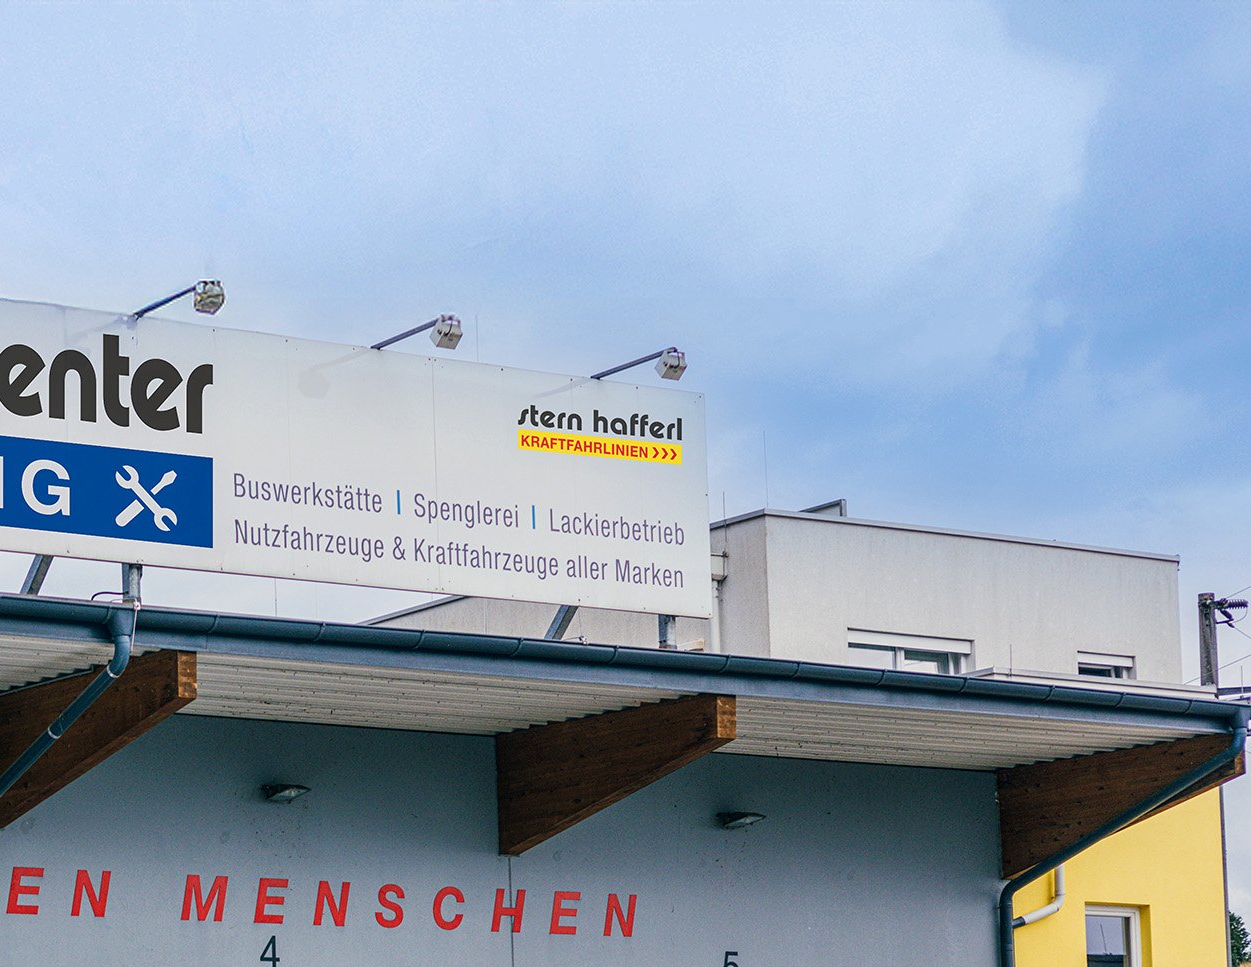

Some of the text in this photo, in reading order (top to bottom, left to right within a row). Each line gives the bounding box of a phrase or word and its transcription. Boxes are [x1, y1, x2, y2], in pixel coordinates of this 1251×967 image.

[518, 405, 683, 441] stern hafferl
[521, 435, 649, 459] KRAFTFAHRLINIEN
[233, 473, 685, 545] Buswerkstätte Spenglerei Lackierbetrieb
[234, 520, 685, 588] Nutzfahrzeuge & Kraftfahrzeuge aller Marken
[180, 873, 638, 938] MENSCHEN
